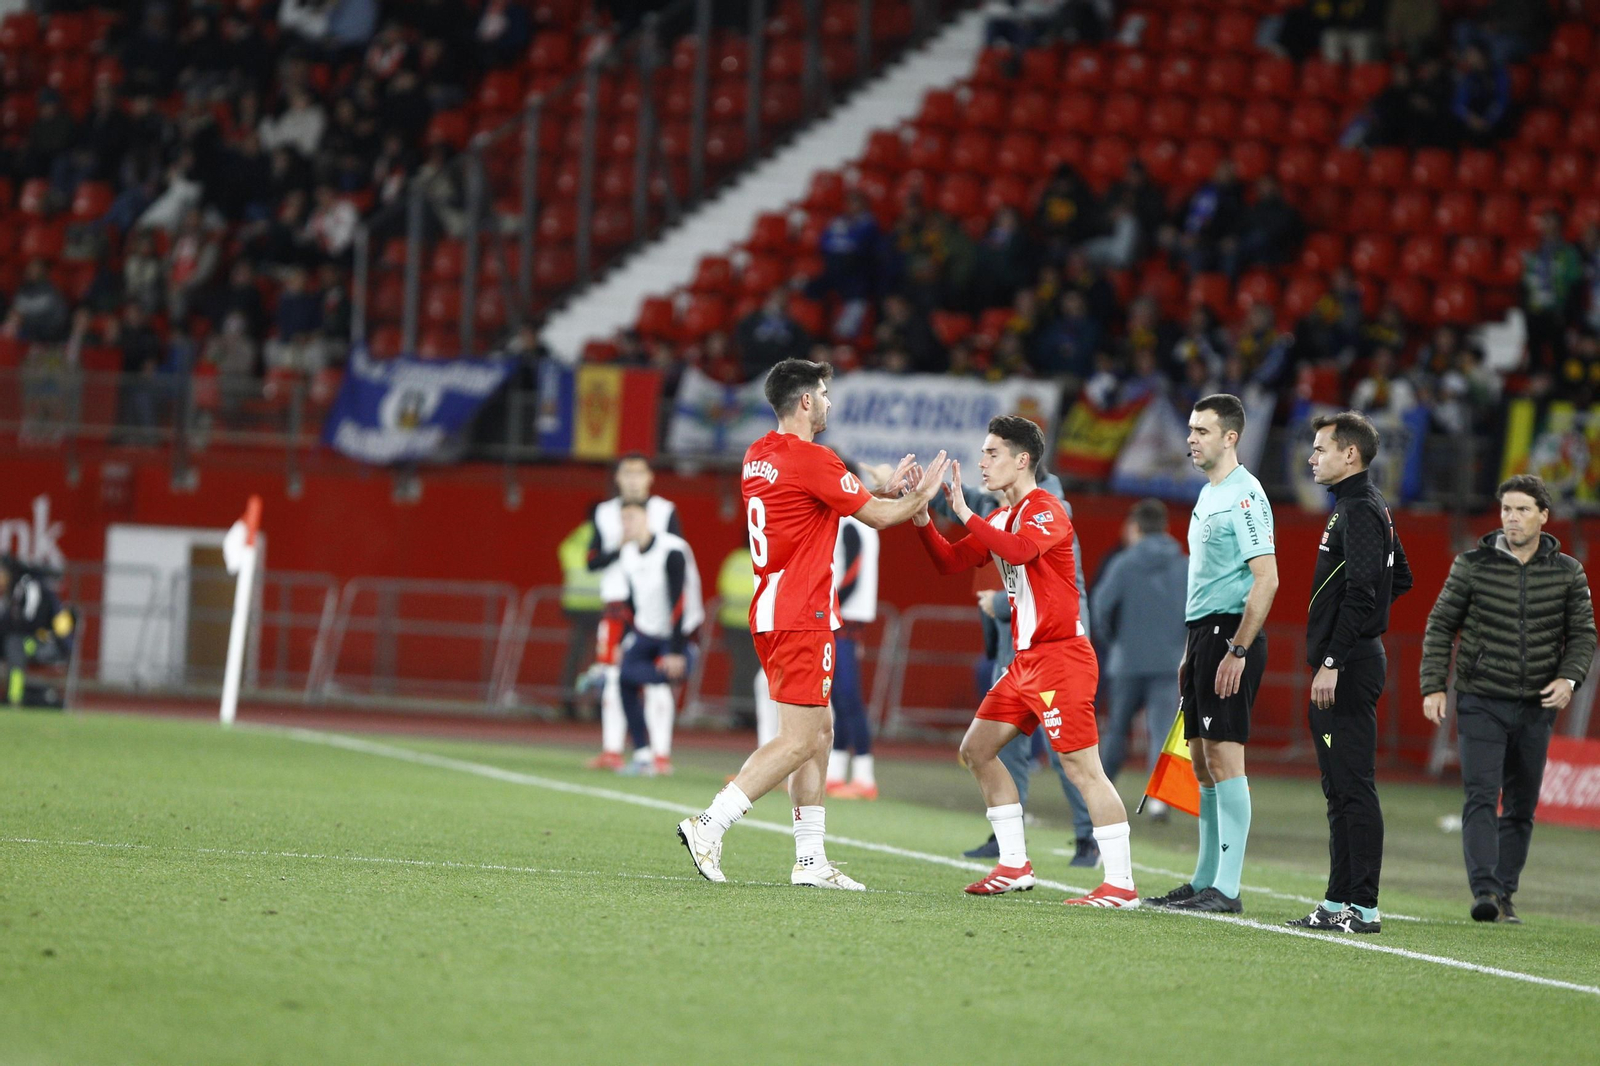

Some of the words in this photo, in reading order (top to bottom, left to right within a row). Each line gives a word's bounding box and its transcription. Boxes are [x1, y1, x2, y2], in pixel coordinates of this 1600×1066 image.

[743, 461, 779, 485] MELERO
[748, 496, 768, 568] 8
[1244, 510, 1260, 546] WÜRTH
[822, 642, 832, 672] 8
[1044, 716, 1063, 728] KUDU
